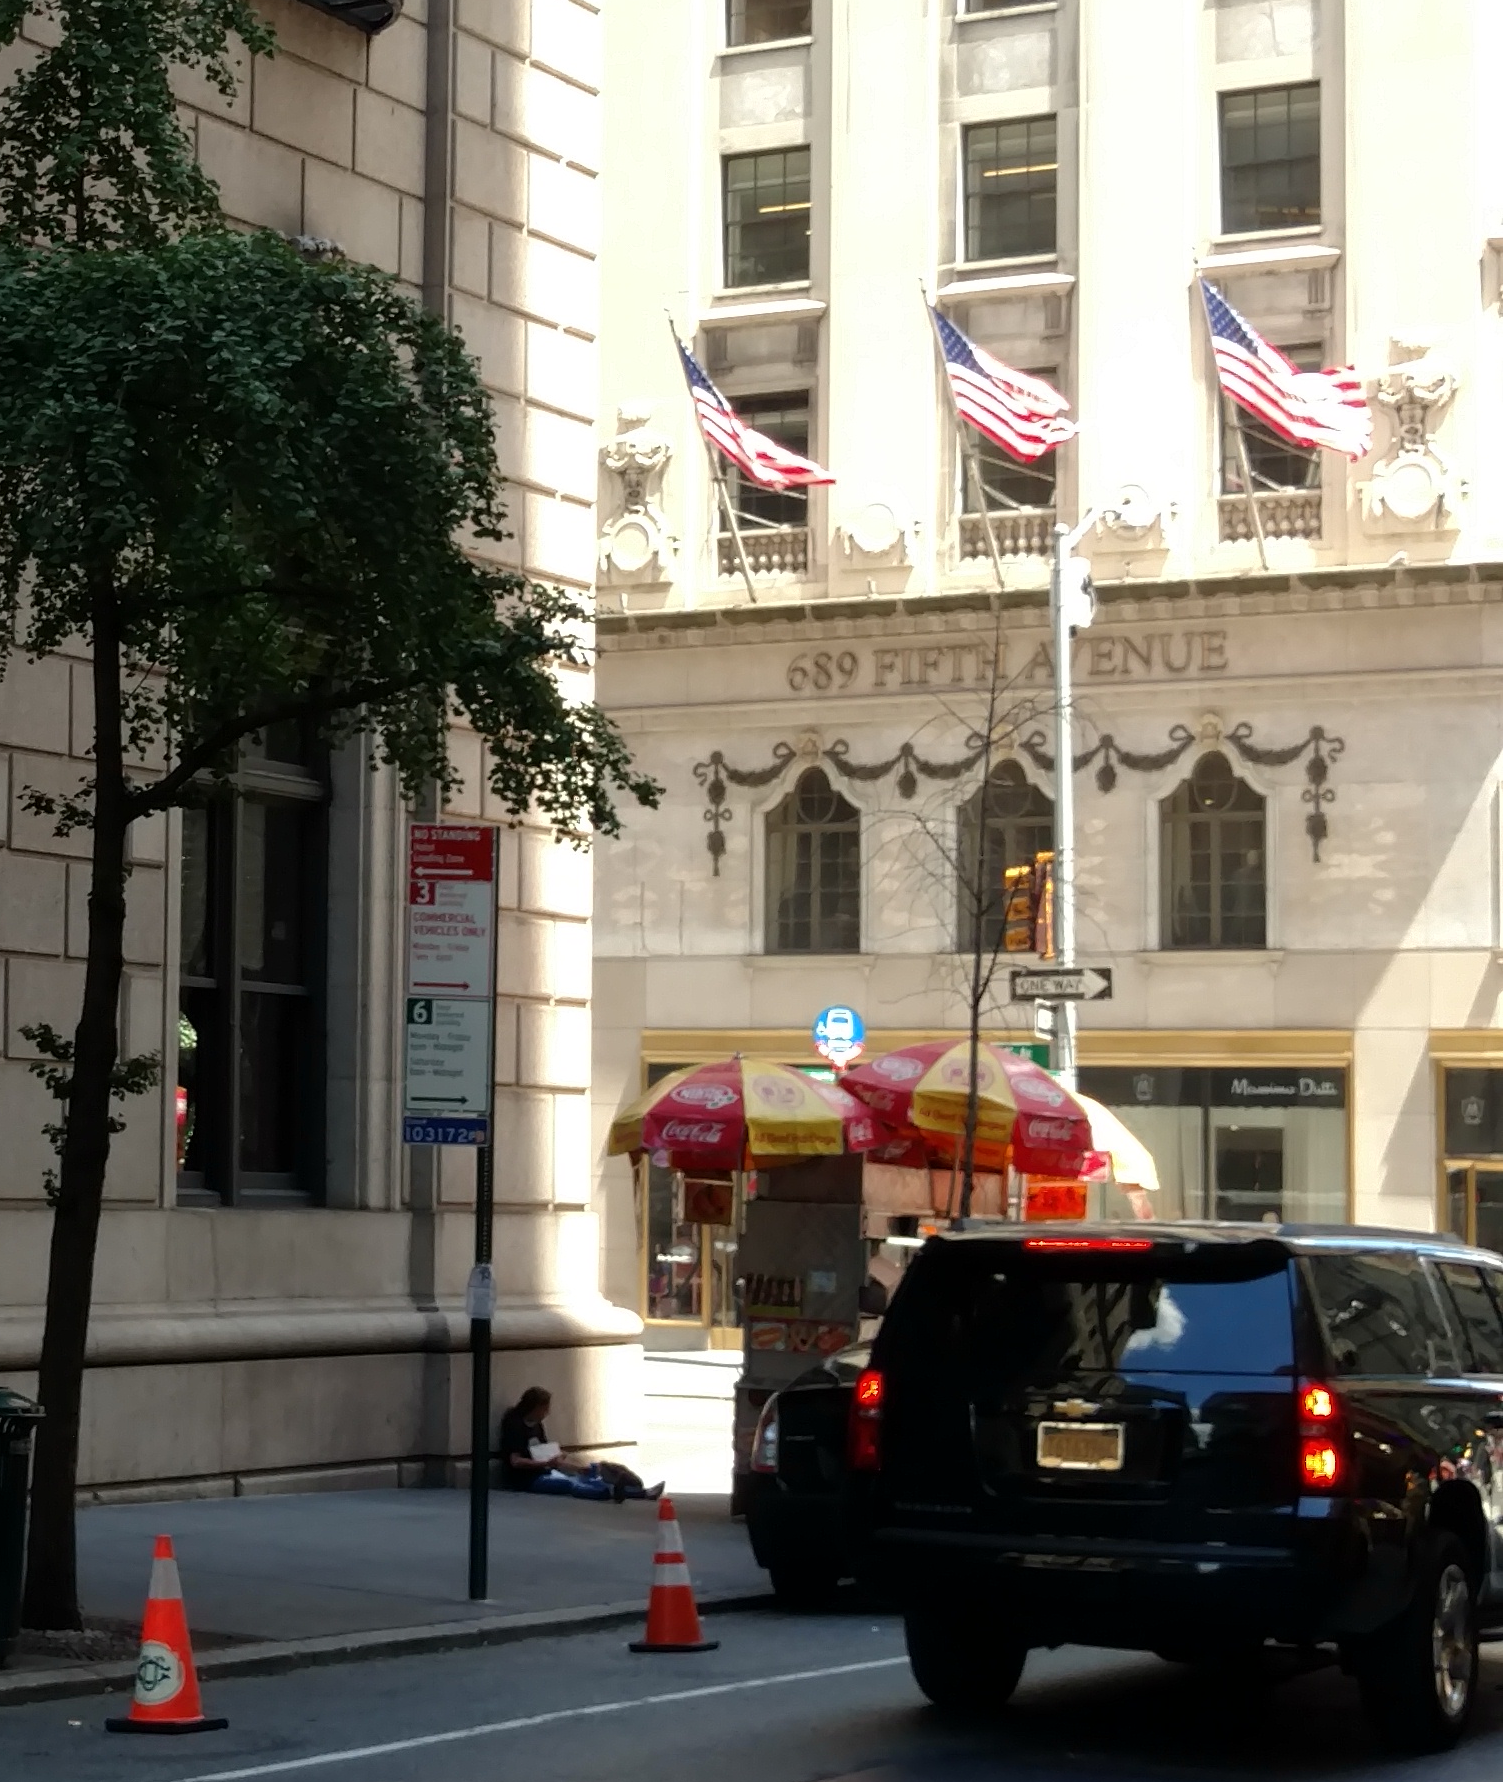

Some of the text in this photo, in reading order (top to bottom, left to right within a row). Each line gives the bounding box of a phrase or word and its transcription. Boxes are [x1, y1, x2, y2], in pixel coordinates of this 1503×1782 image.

[786, 650, 859, 692] 689
[874, 642, 1009, 688] FIFTH
[416, 880, 430, 903] 3
[1020, 978, 1049, 991] ONE
[413, 1000, 428, 1023] 6
